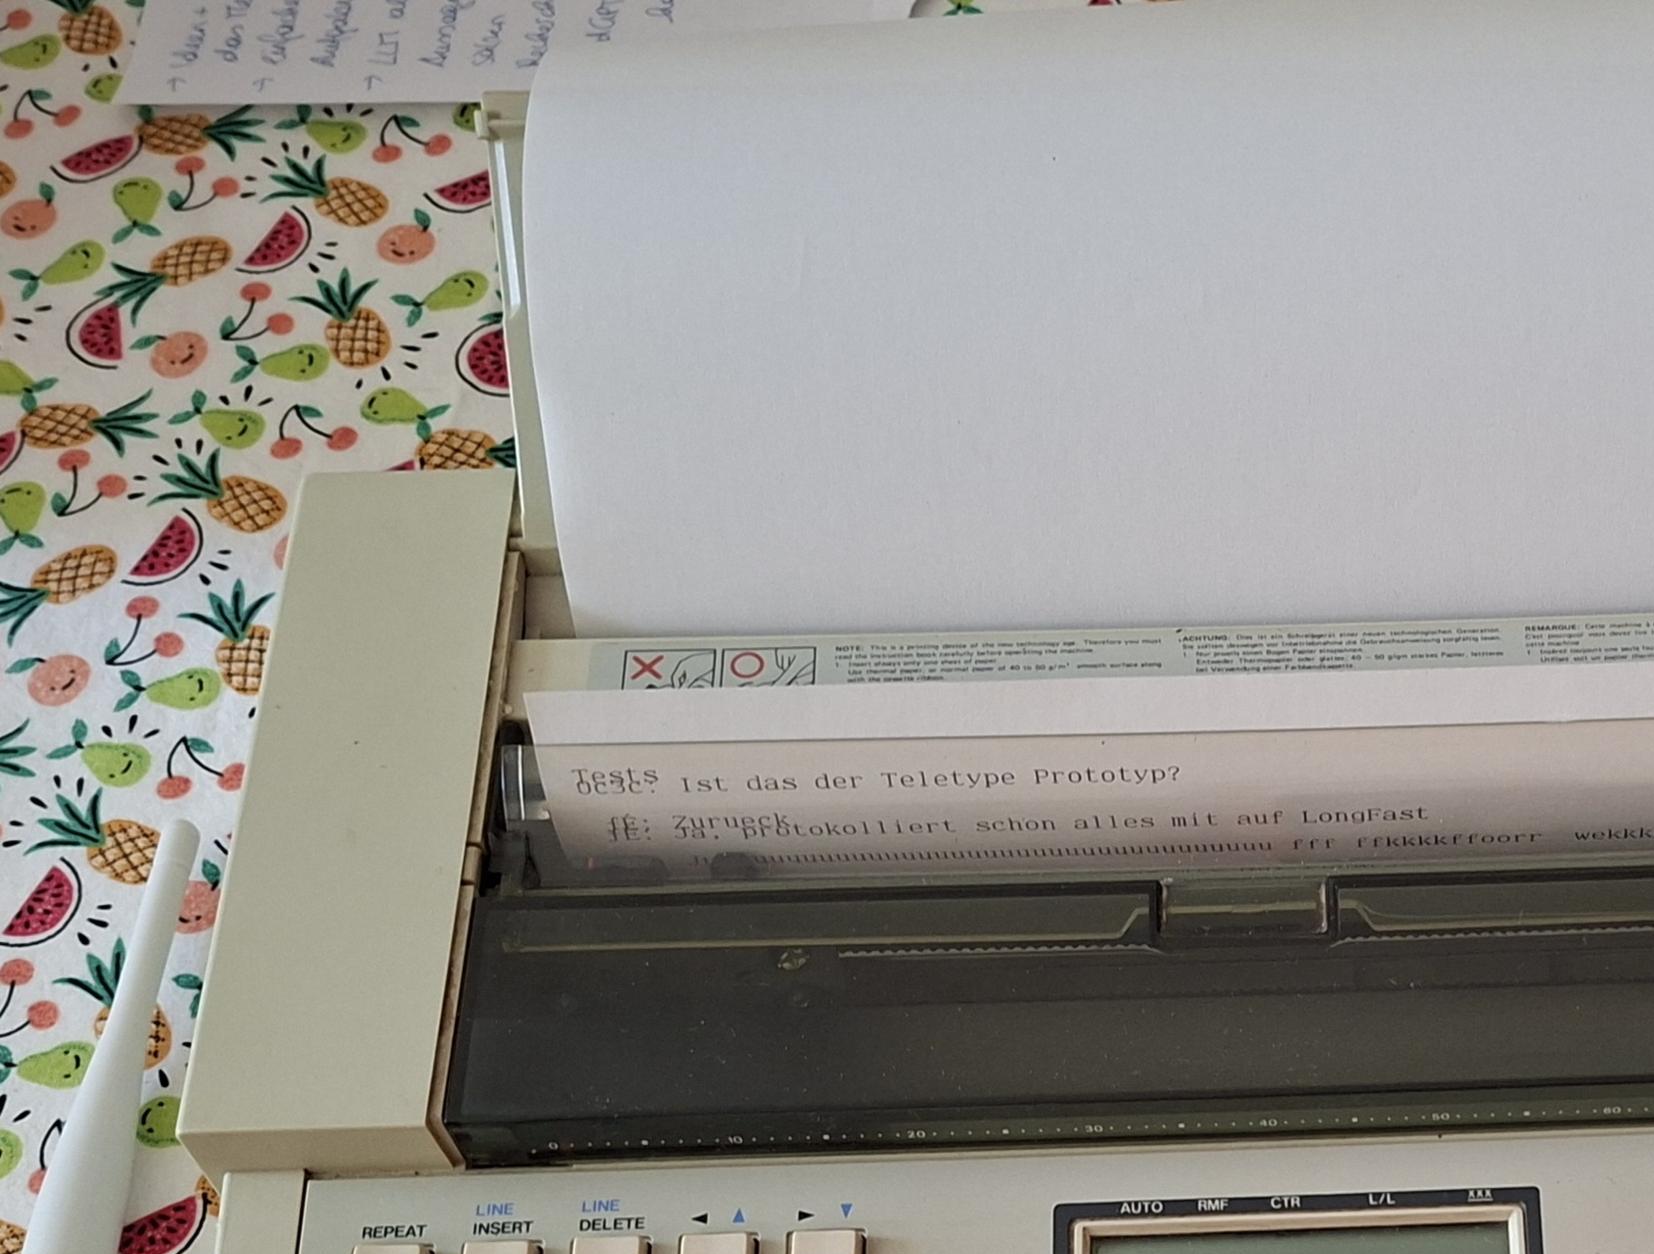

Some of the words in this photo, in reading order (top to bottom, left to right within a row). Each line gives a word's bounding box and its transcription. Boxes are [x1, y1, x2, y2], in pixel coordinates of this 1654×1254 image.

[681, 776, 728, 793] Ist
[747, 775, 797, 791] das
[815, 773, 864, 790] der
[880, 769, 1016, 789] Teletype
[1033, 766, 1180, 785] Prototyp?
[975, 816, 1056, 833] schon
[1074, 814, 1155, 829] alles
[1172, 812, 1218, 828] mit
[1237, 810, 1284, 826] auf
[1302, 807, 1429, 825] LongFast
[581, 1200, 621, 1213] LINE
[1197, 1198, 1230, 1212] RMF
[1270, 1196, 1301, 1210] CTR
[1368, 1193, 1396, 1206] L/L
[475, 1203, 516, 1217] LINE
[1120, 1201, 1164, 1215] AUTO
[472, 1220, 534, 1236] INSERT
[578, 1217, 646, 1233] DELETE
[362, 1225, 428, 1240] REPEAT
